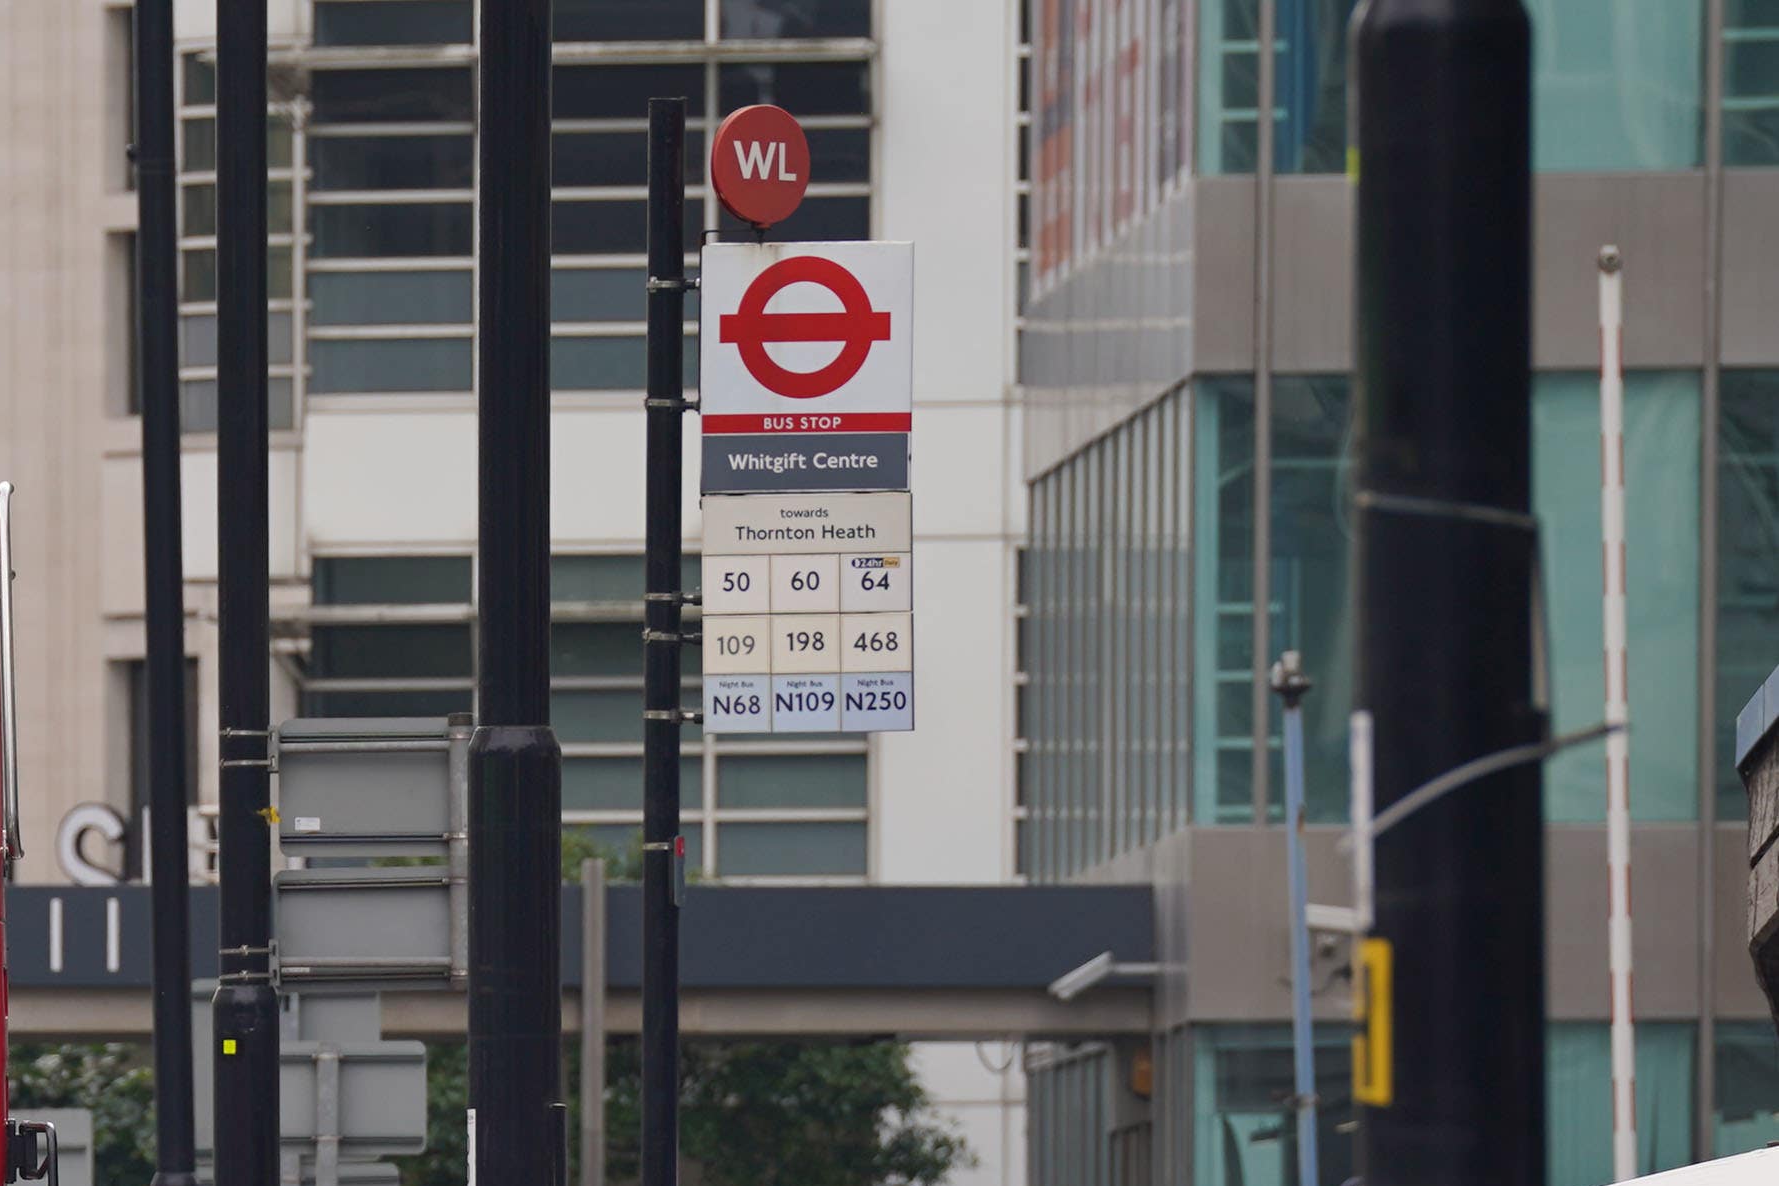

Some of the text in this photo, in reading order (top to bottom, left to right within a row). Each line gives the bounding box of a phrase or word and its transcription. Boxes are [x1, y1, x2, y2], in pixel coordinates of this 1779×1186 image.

[733, 140, 797, 182] WL
[763, 416, 842, 430] BUS STOP
[728, 452, 879, 473] Whitgift Centre
[780, 507, 829, 519] towards
[735, 524, 876, 541] Thornton Heath
[859, 558, 883, 568] 24hr
[722, 572, 751, 592] 50
[790, 571, 820, 591] 60
[860, 571, 890, 590] 64
[717, 635, 756, 655] 109
[786, 631, 825, 651] 198
[853, 631, 899, 651] 468
[719, 681, 739, 690] Night
[787, 680, 807, 689] Night
[857, 679, 878, 688] Night
[713, 695, 761, 715] N68
[775, 691, 835, 712] N109
[845, 691, 907, 711] N250
